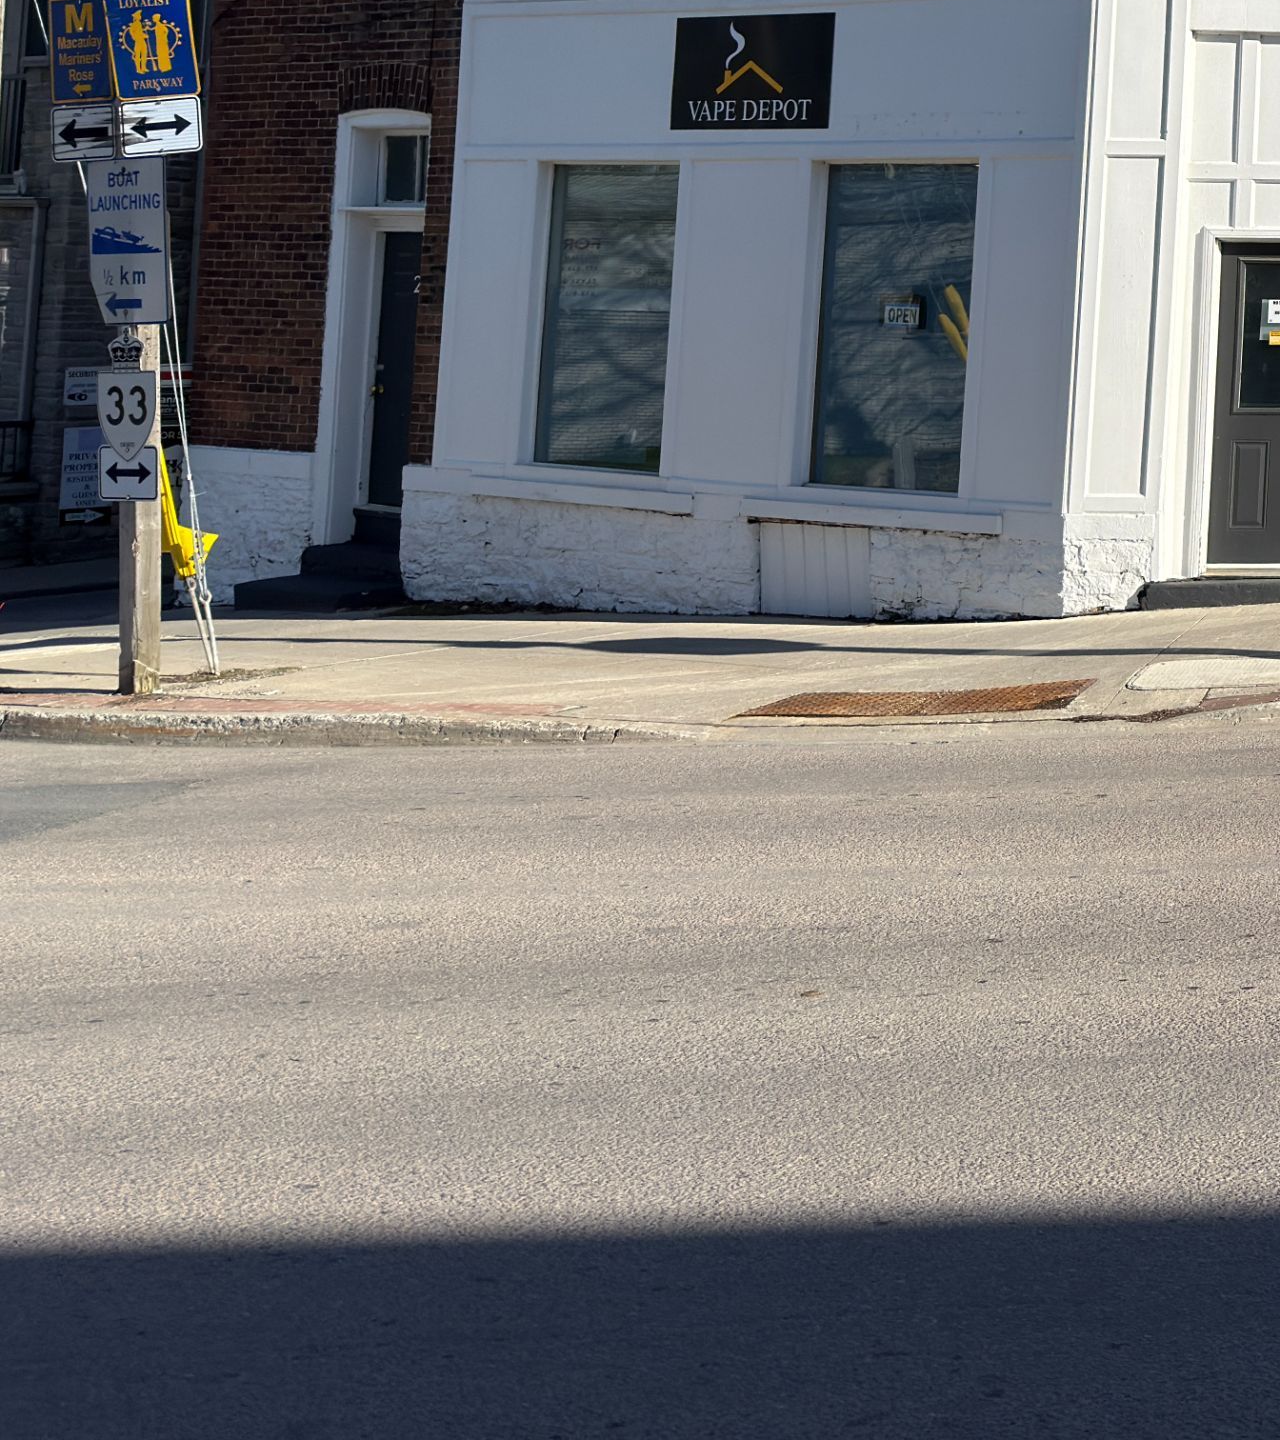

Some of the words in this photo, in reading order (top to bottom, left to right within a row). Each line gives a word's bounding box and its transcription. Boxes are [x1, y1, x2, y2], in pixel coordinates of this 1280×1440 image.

[65, 2, 93, 34] M
[57, 35, 103, 50] Macaulay
[58, 51, 103, 65] Mariners'
[68, 69, 95, 81] Rose
[132, 77, 184, 90] PARKWAY
[688, 100, 737, 121] VAPE
[742, 99, 812, 121] DEPOT
[107, 171, 140, 187] BOAT
[90, 193, 160, 212] LAUNCHING
[120, 265, 146, 285] km
[888, 308, 918, 323] OPEN
[106, 385, 147, 426] 33
[69, 453, 98, 461] PRIVA
[64, 462, 98, 471] PROPE
